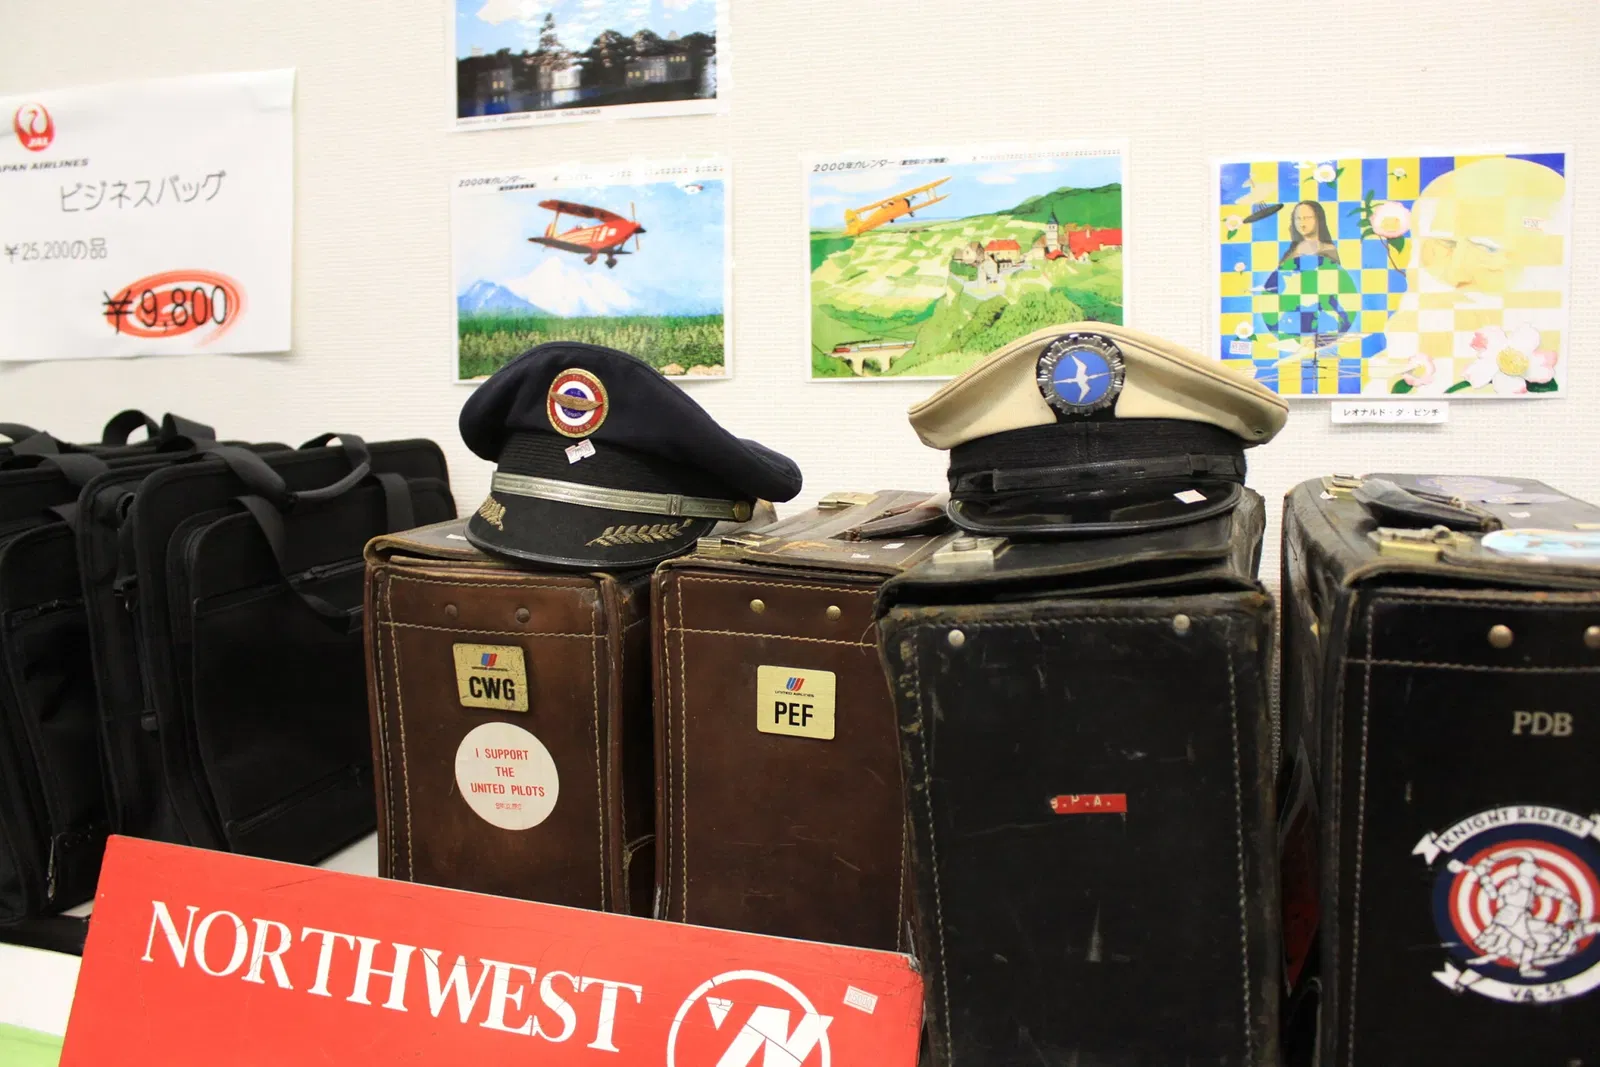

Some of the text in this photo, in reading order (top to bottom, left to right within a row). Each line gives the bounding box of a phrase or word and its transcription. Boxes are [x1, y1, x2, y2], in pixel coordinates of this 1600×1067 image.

[31, 157, 89, 171] AIRLINES
[60, 169, 227, 213] ビジネスバッグ
[4, 237, 108, 264] ¥25,200の品
[102, 285, 228, 335] ¥9,800
[468, 675, 516, 701] CWG
[774, 700, 814, 727] PEF
[1512, 710, 1574, 738] PDB
[475, 747, 529, 761] I SUPPORT
[494, 766, 516, 779] THE
[470, 782, 546, 798] UNITED PILOTS
[1441, 806, 1585, 848] KNIGHT RIDERS
[140, 899, 644, 1054] NORTHWEST
